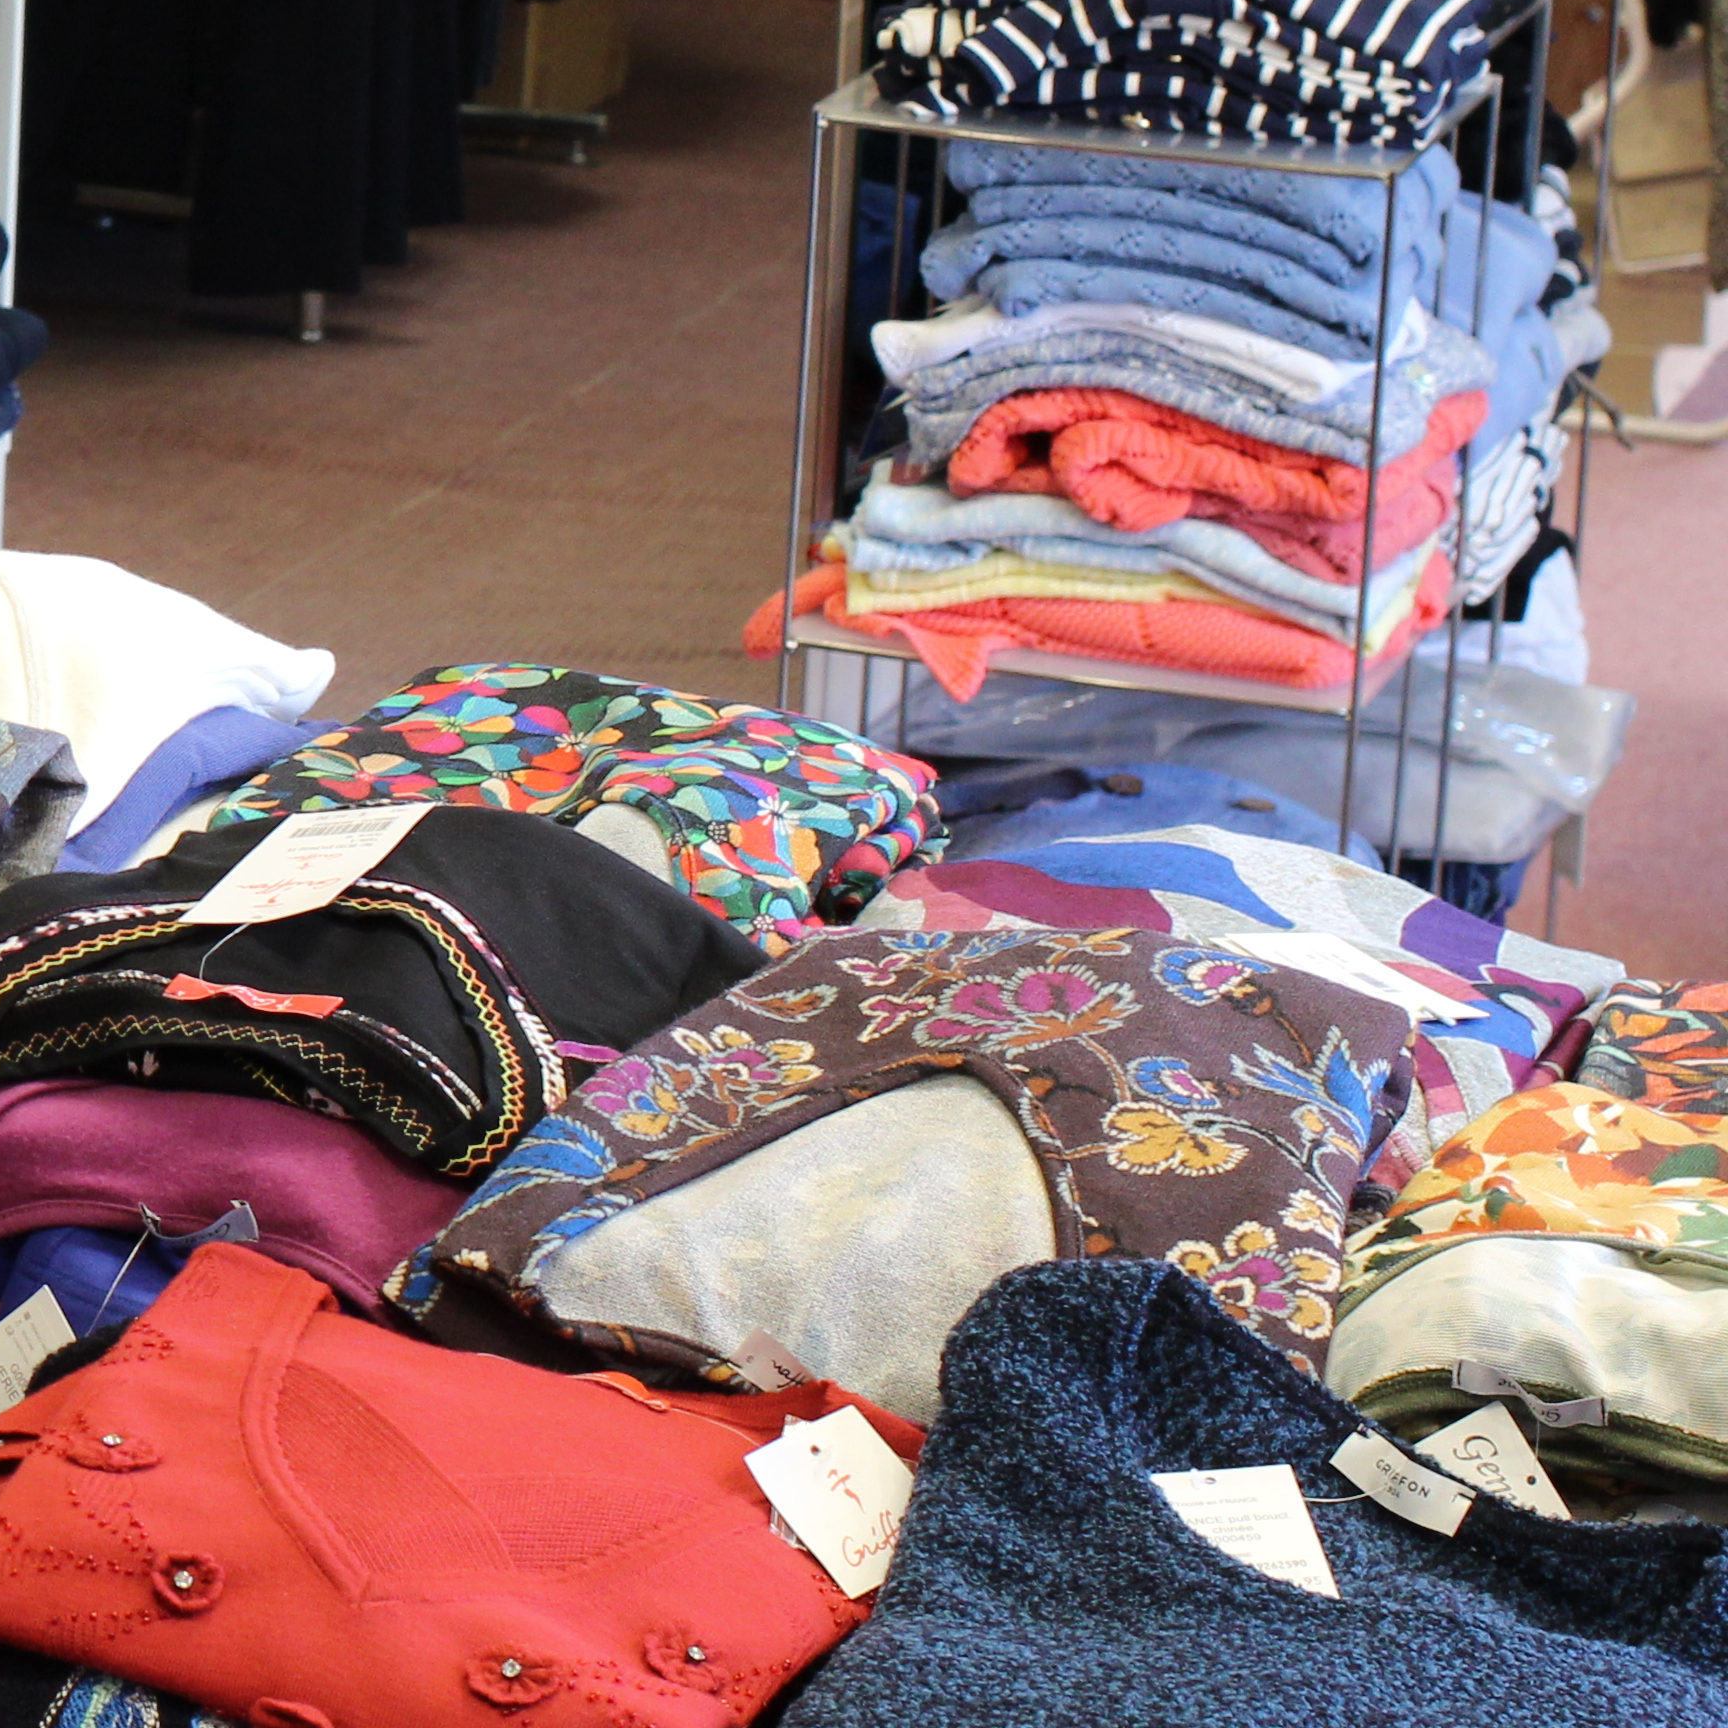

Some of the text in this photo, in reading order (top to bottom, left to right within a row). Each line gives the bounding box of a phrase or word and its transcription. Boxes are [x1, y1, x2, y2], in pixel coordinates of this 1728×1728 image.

[1374, 1457, 1432, 1500] GRIFFON
[841, 1509, 901, 1568] Griff
[1184, 1515, 1226, 1526] ANCE
[1228, 1513, 1252, 1525] pull
